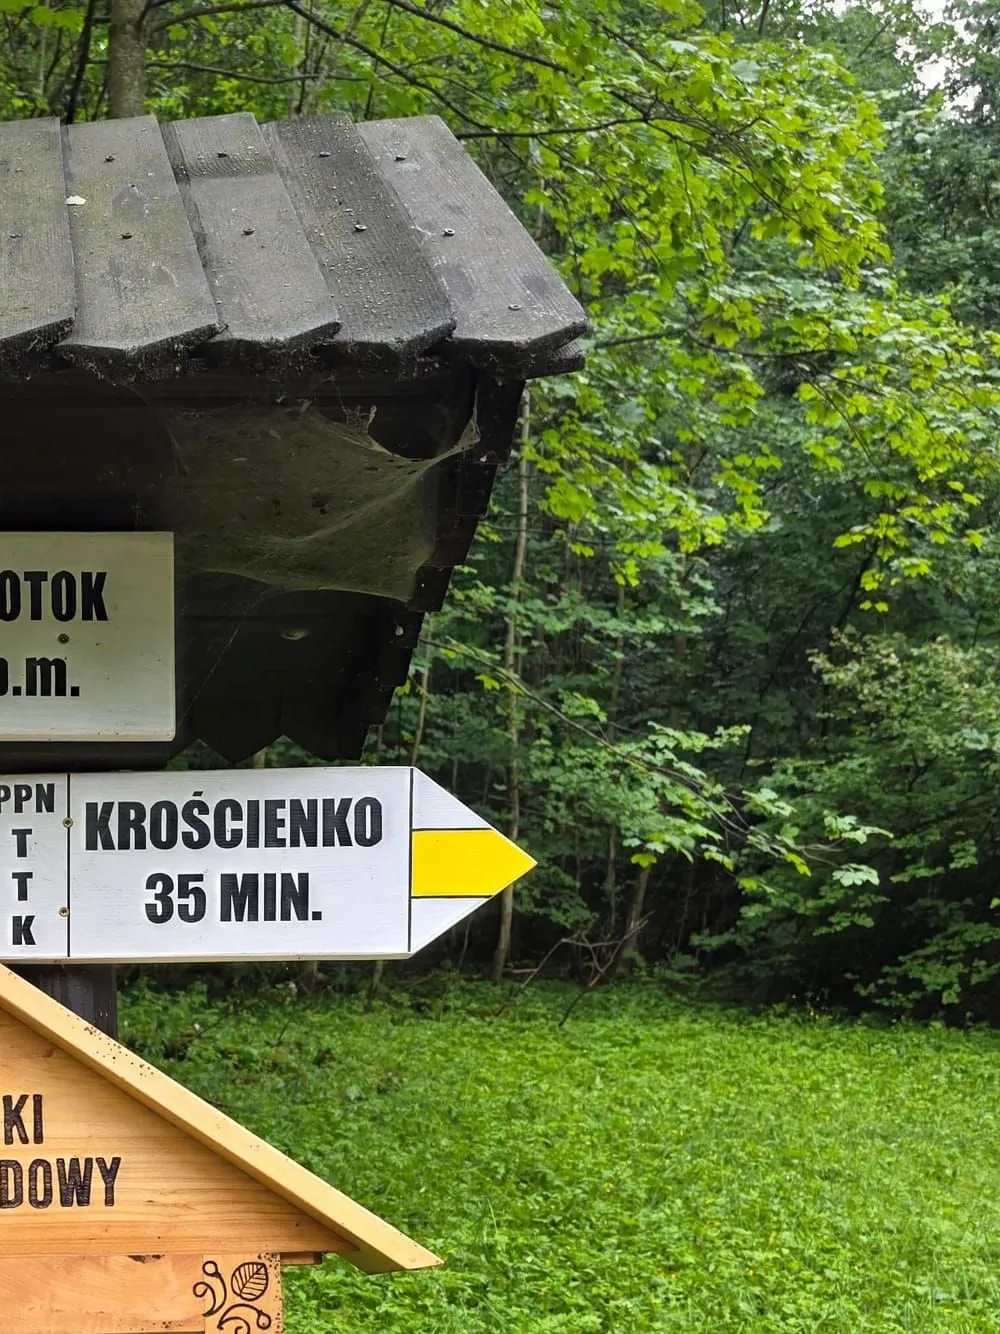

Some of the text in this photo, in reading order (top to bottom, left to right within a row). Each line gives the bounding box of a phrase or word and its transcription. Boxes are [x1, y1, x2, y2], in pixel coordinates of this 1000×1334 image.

[86, 791, 382, 850] KROŚCIENKO
[12, 829, 32, 857] T
[12, 872, 33, 901] T
[145, 873, 321, 923] 35 MIN.
[13, 916, 35, 945] K
